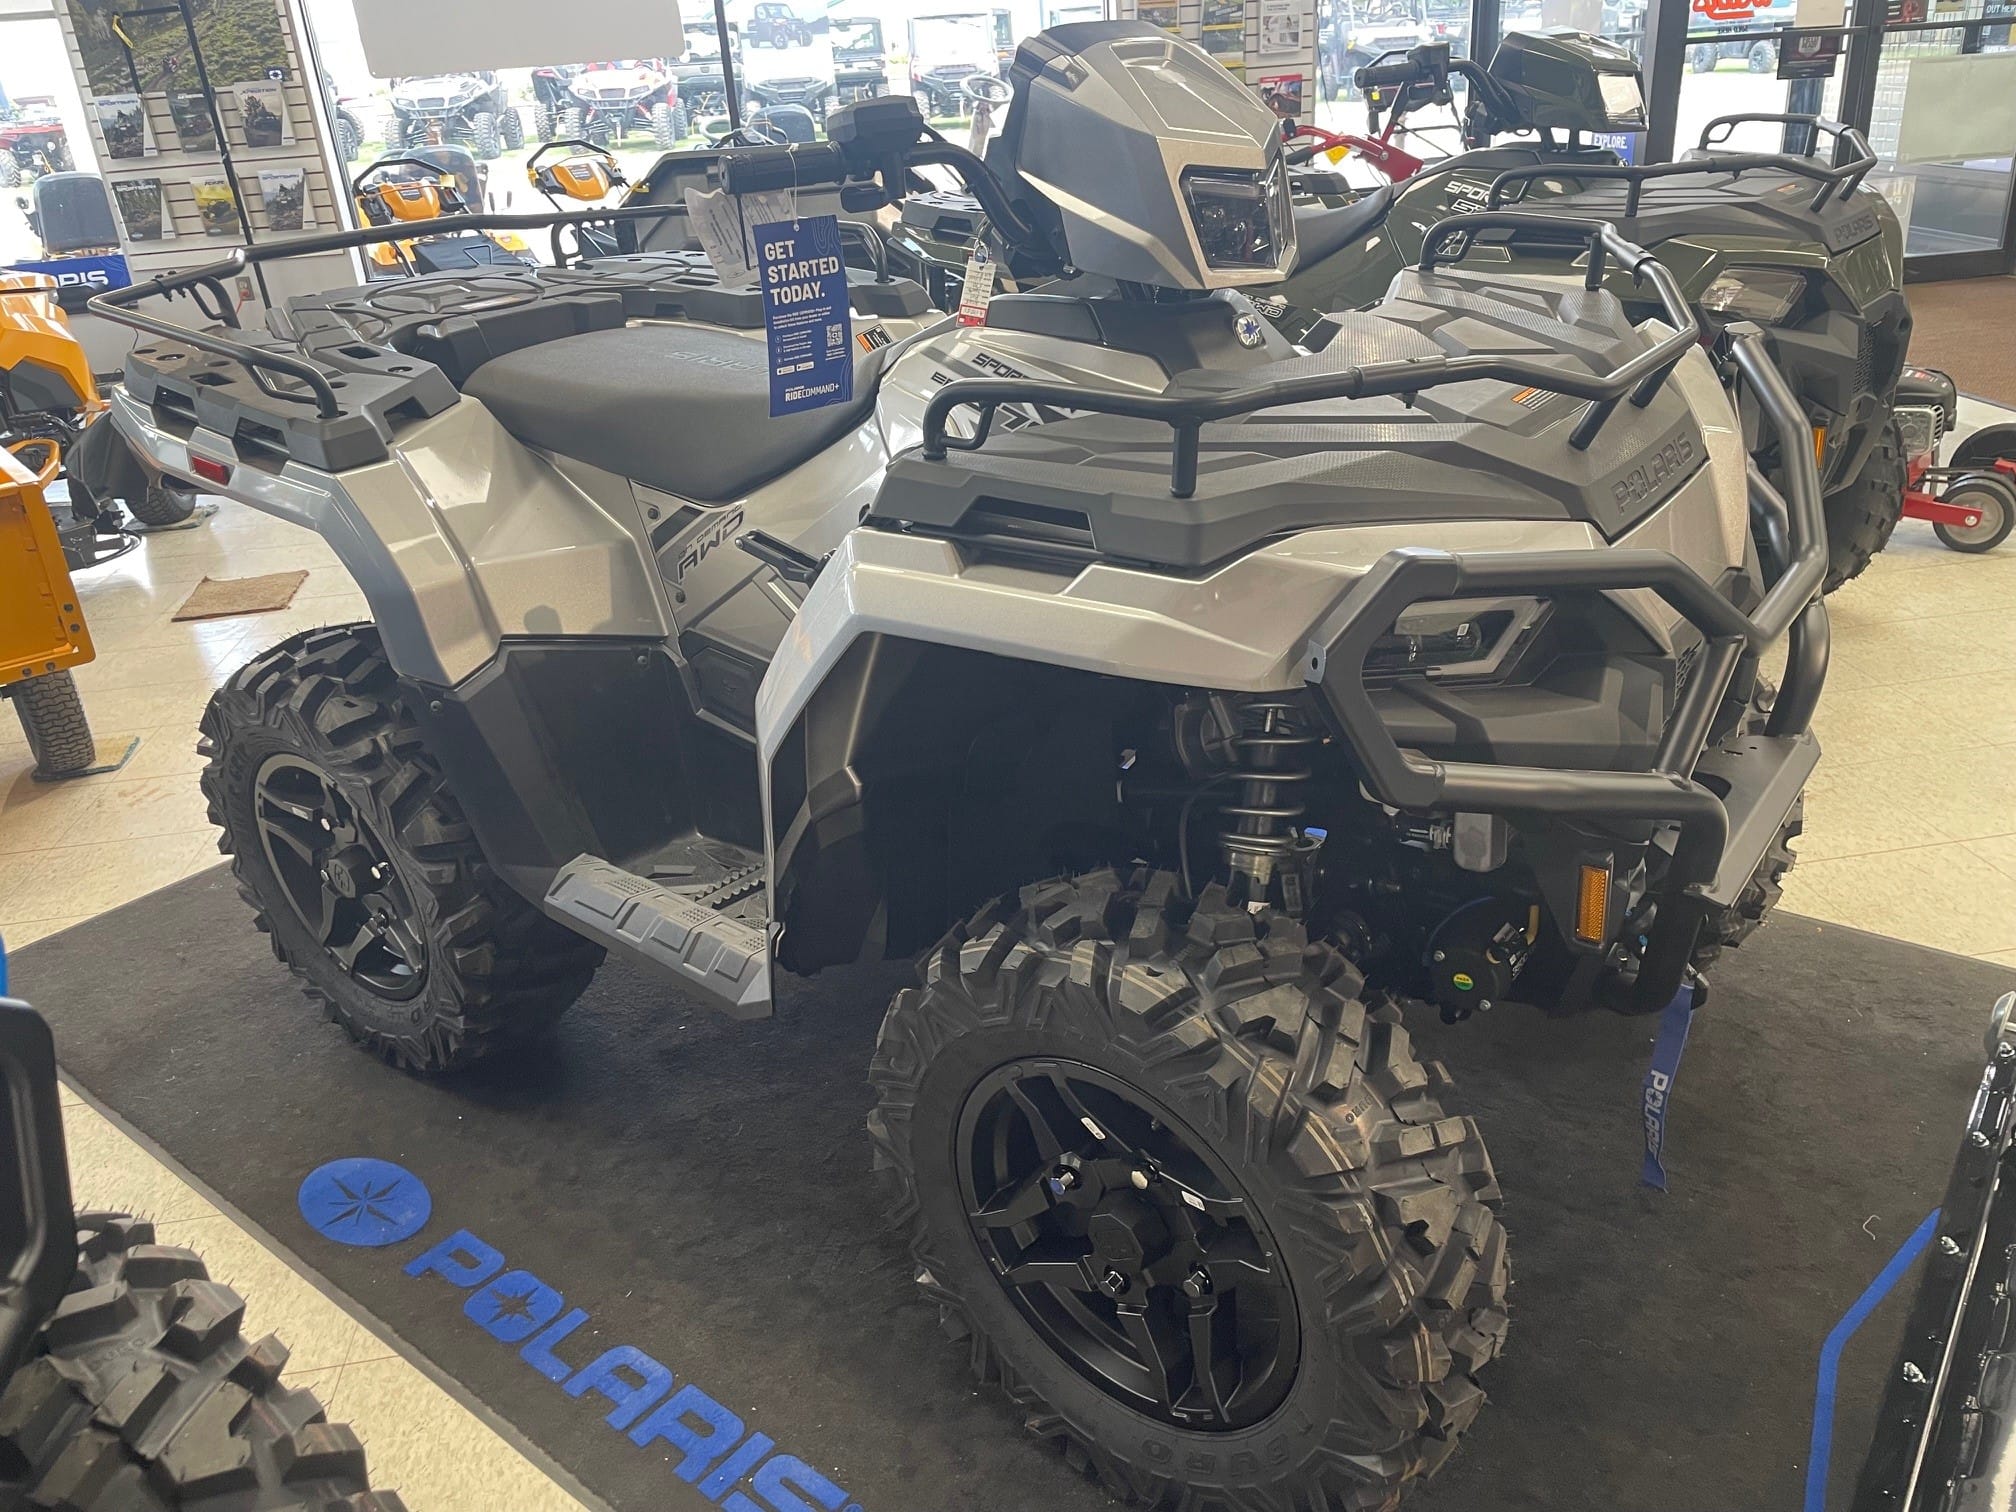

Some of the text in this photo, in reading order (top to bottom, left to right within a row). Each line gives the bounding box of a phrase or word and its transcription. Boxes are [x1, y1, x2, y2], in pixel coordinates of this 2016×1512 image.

[764, 240, 795, 261] GET
[767, 256, 840, 284] STARTED
[770, 281, 826, 306] TODAY.
[1611, 432, 1695, 515] POLARIS
[679, 511, 744, 581] AWD
[403, 1228, 850, 1512] POLARIS
